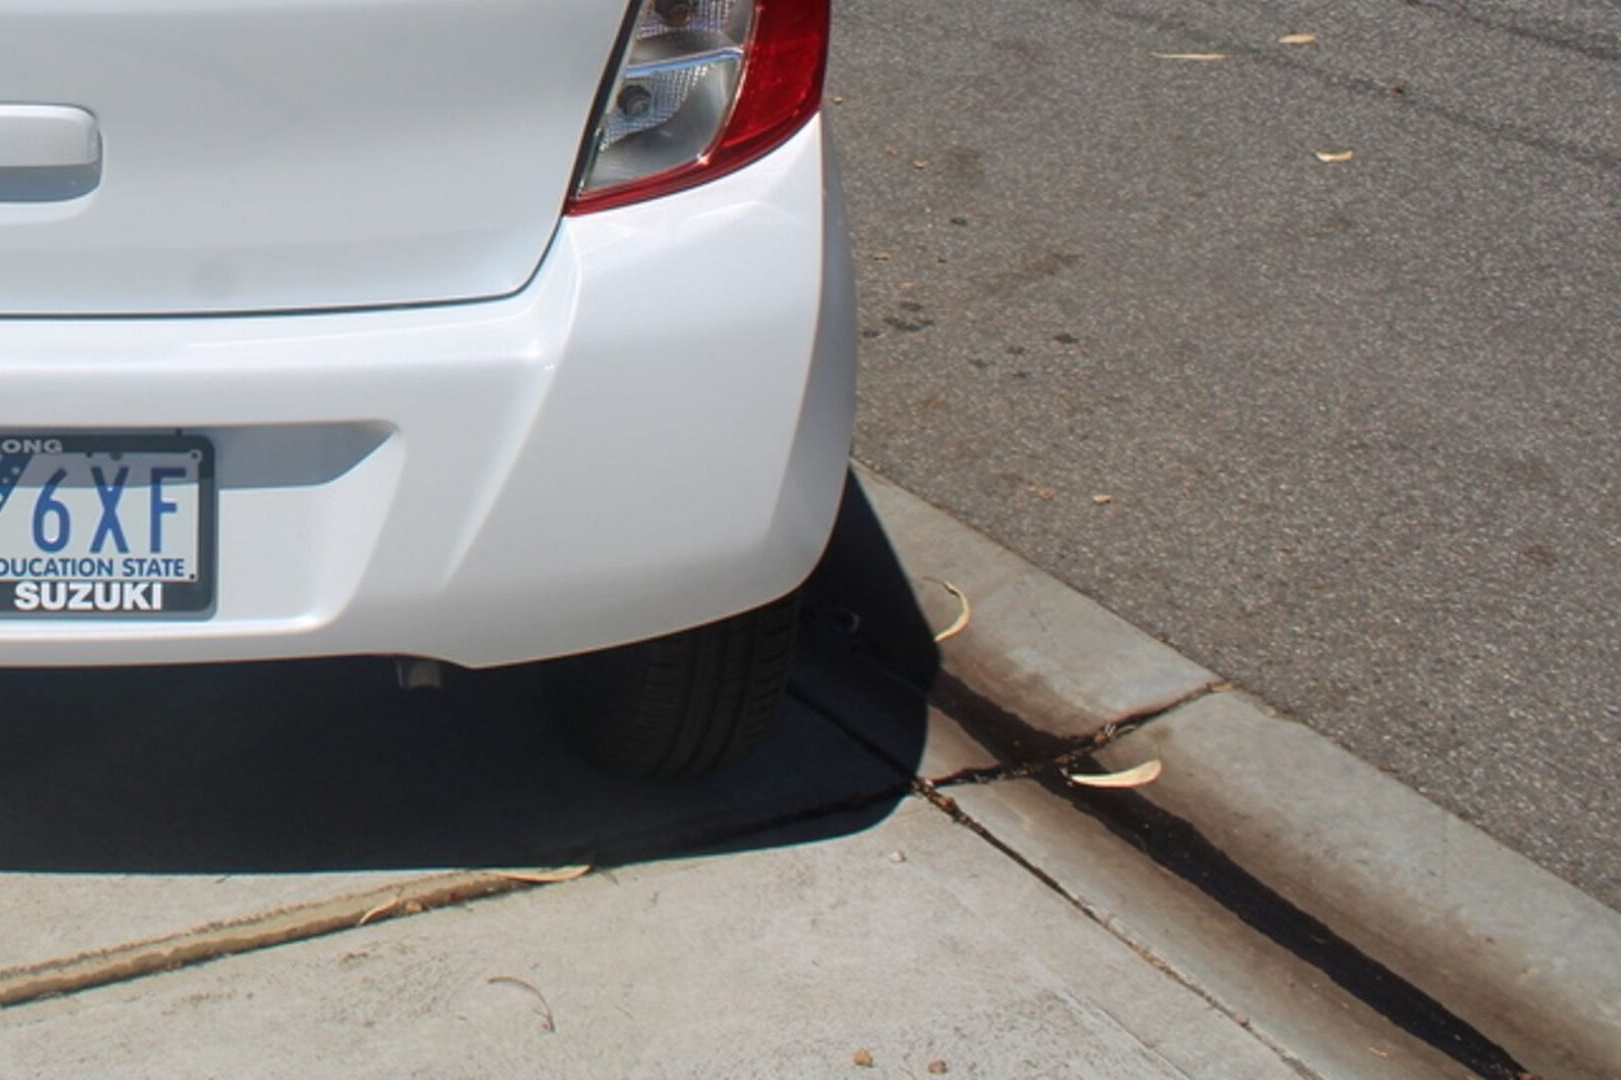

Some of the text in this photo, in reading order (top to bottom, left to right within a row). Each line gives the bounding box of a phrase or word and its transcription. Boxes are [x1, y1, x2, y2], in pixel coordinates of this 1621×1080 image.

[32, 467, 187, 554] 6XF
[122, 557, 185, 578] STATE
[13, 580, 163, 611] SUZUKI
